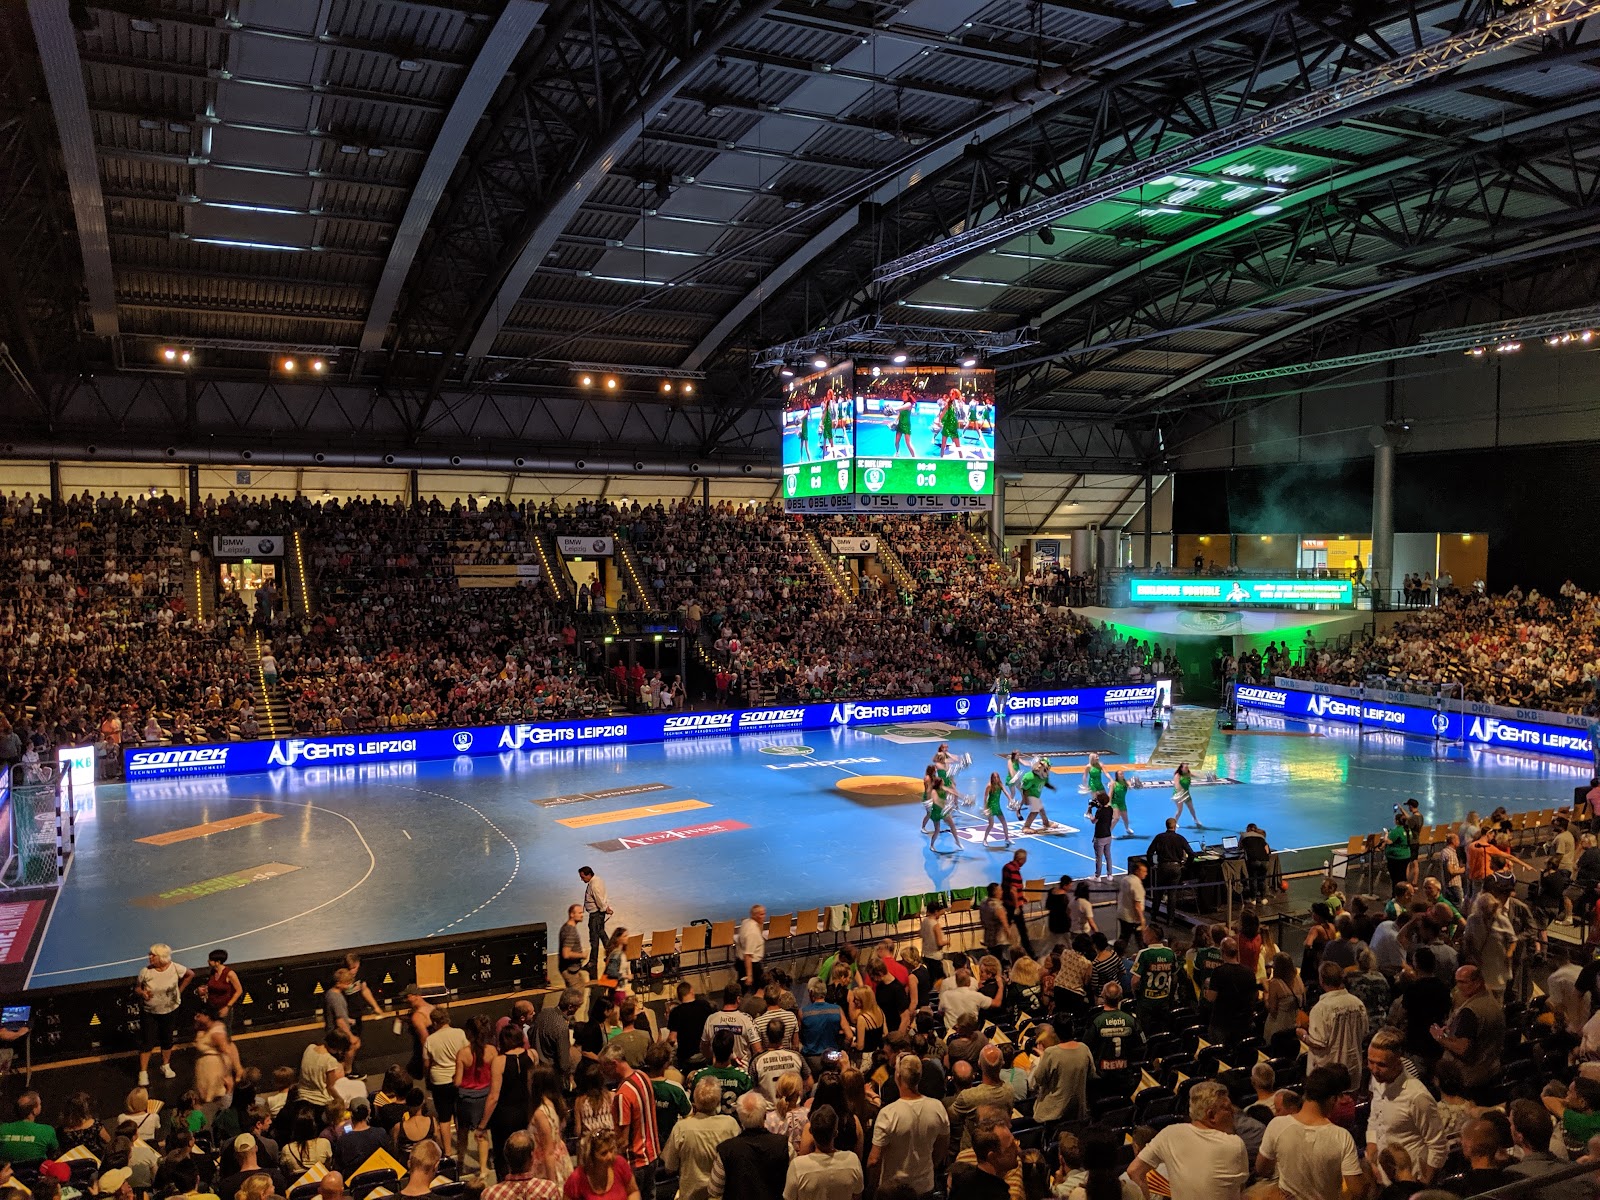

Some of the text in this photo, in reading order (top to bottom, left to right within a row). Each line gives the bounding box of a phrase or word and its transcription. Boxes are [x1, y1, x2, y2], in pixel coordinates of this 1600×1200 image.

[916, 474, 936, 487] 0:0
[870, 496, 899, 506] TSL
[915, 496, 944, 506] TSL
[958, 496, 986, 506] TSL
[222, 538, 244, 546] BMW
[223, 546, 250, 554] Leipzig
[1010, 696, 1041, 710] GEHTS
[1042, 696, 1079, 706] LEIPZIG!
[854, 705, 890, 719] GEHTS
[892, 704, 931, 716] LEIPZIG!
[1328, 700, 1360, 717] GEHTS
[1472, 704, 1490, 714] DKB
[1516, 710, 1538, 720] DKB
[1566, 716, 1588, 726] DKB
[530, 728, 574, 744] GEHTS
[577, 725, 628, 740] LEIPZIG!
[1497, 725, 1540, 744] GEHTS
[304, 744, 356, 760] GEHTS
[358, 740, 416, 755] LEIPZIG!
[1105, 1018, 1126, 1026] Leipzig
